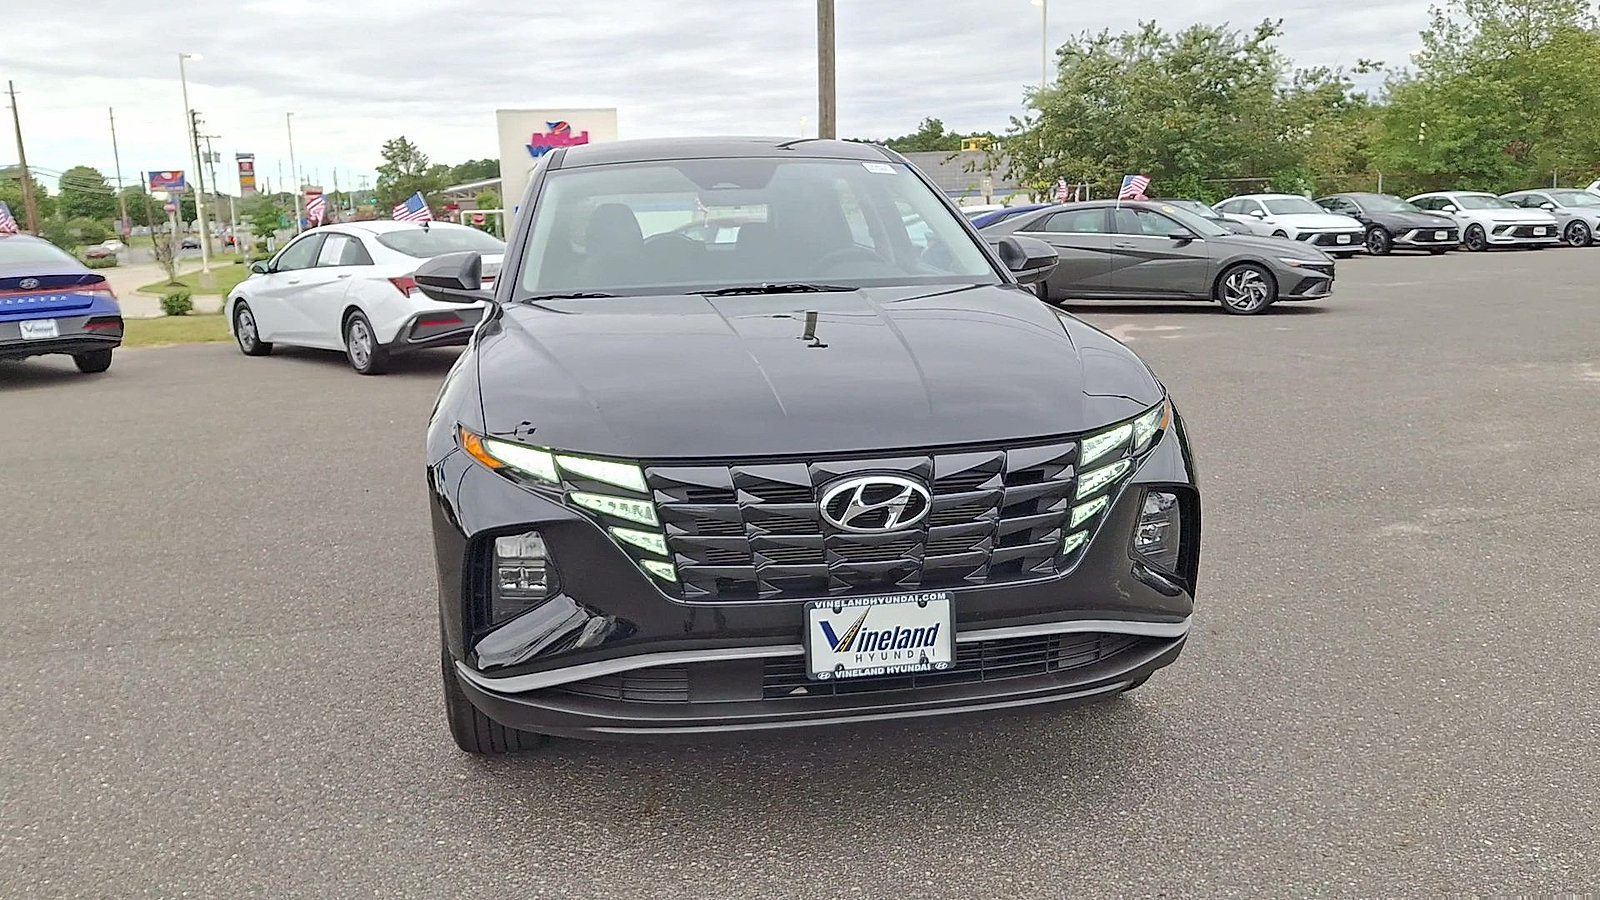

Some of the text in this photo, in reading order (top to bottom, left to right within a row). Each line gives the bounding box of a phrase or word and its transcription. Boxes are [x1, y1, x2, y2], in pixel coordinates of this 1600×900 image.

[0, 295, 67, 305] LANTRA
[814, 592, 947, 609] VINELANDHYUNDAI.COM
[817, 605, 941, 654] Vineland
[855, 648, 936, 663] HYUNDAI
[834, 663, 931, 679] VINELAND HYUNDAI
